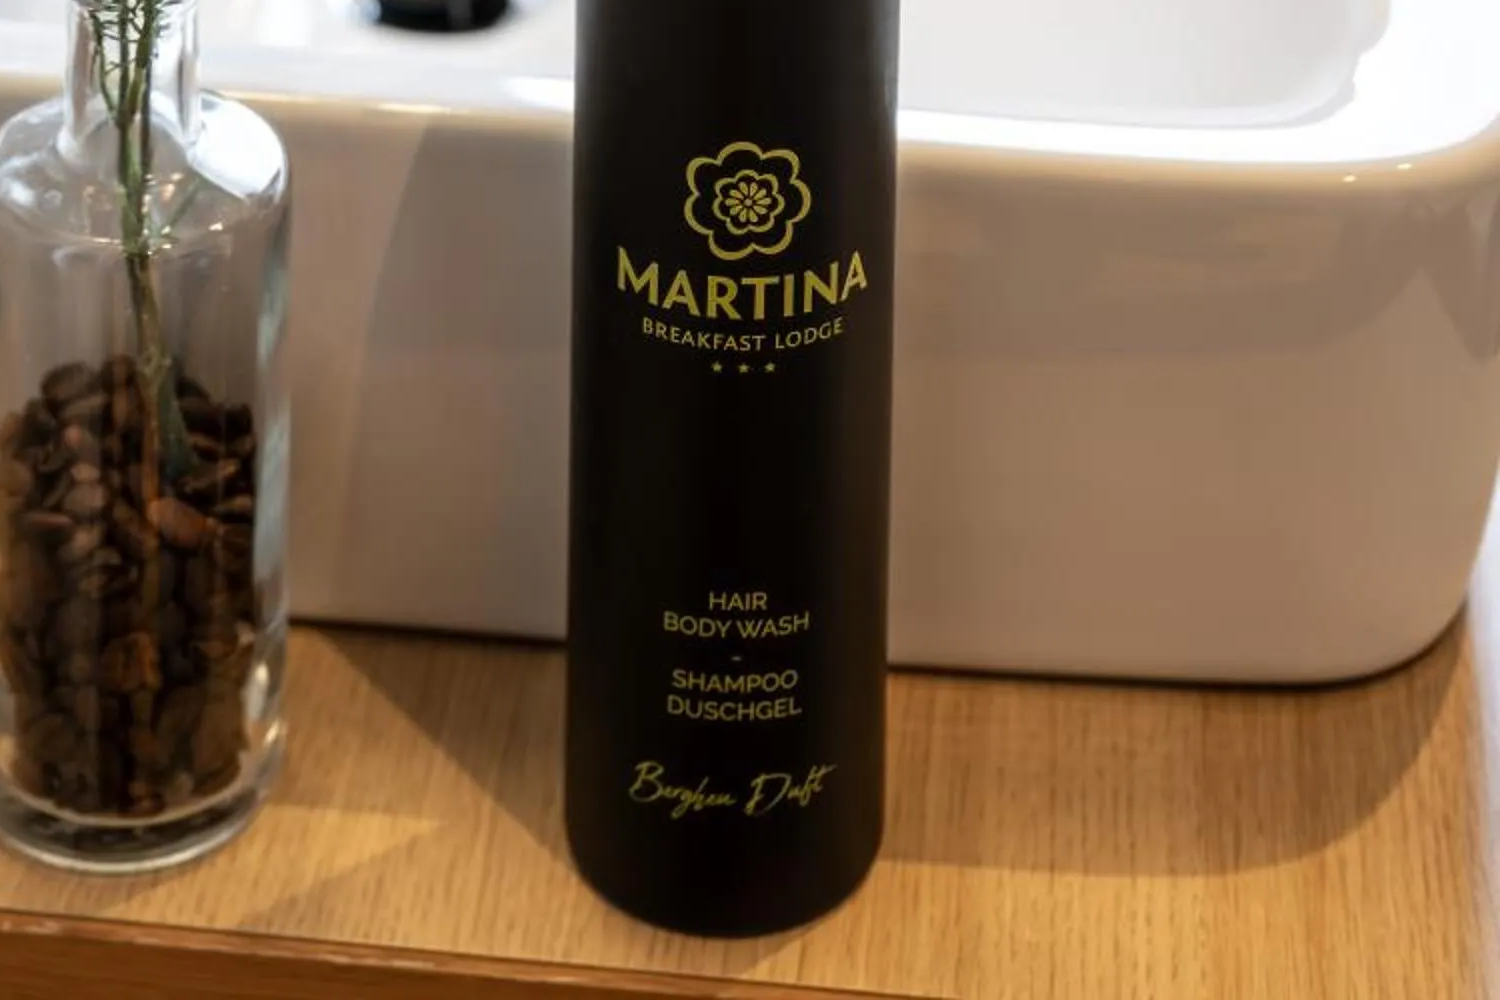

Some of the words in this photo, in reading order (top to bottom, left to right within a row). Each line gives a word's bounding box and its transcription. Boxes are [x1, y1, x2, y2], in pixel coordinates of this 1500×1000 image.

[617, 245, 868, 321] MARTINA
[643, 316, 767, 352] BREAKFAST
[774, 316, 844, 350] LODGE
[708, 592, 768, 612] HAIR
[663, 610, 733, 639] BODY
[736, 611, 811, 639] WASH
[671, 668, 799, 693] SHAMPOO
[666, 695, 803, 722] DUSCHGEL
